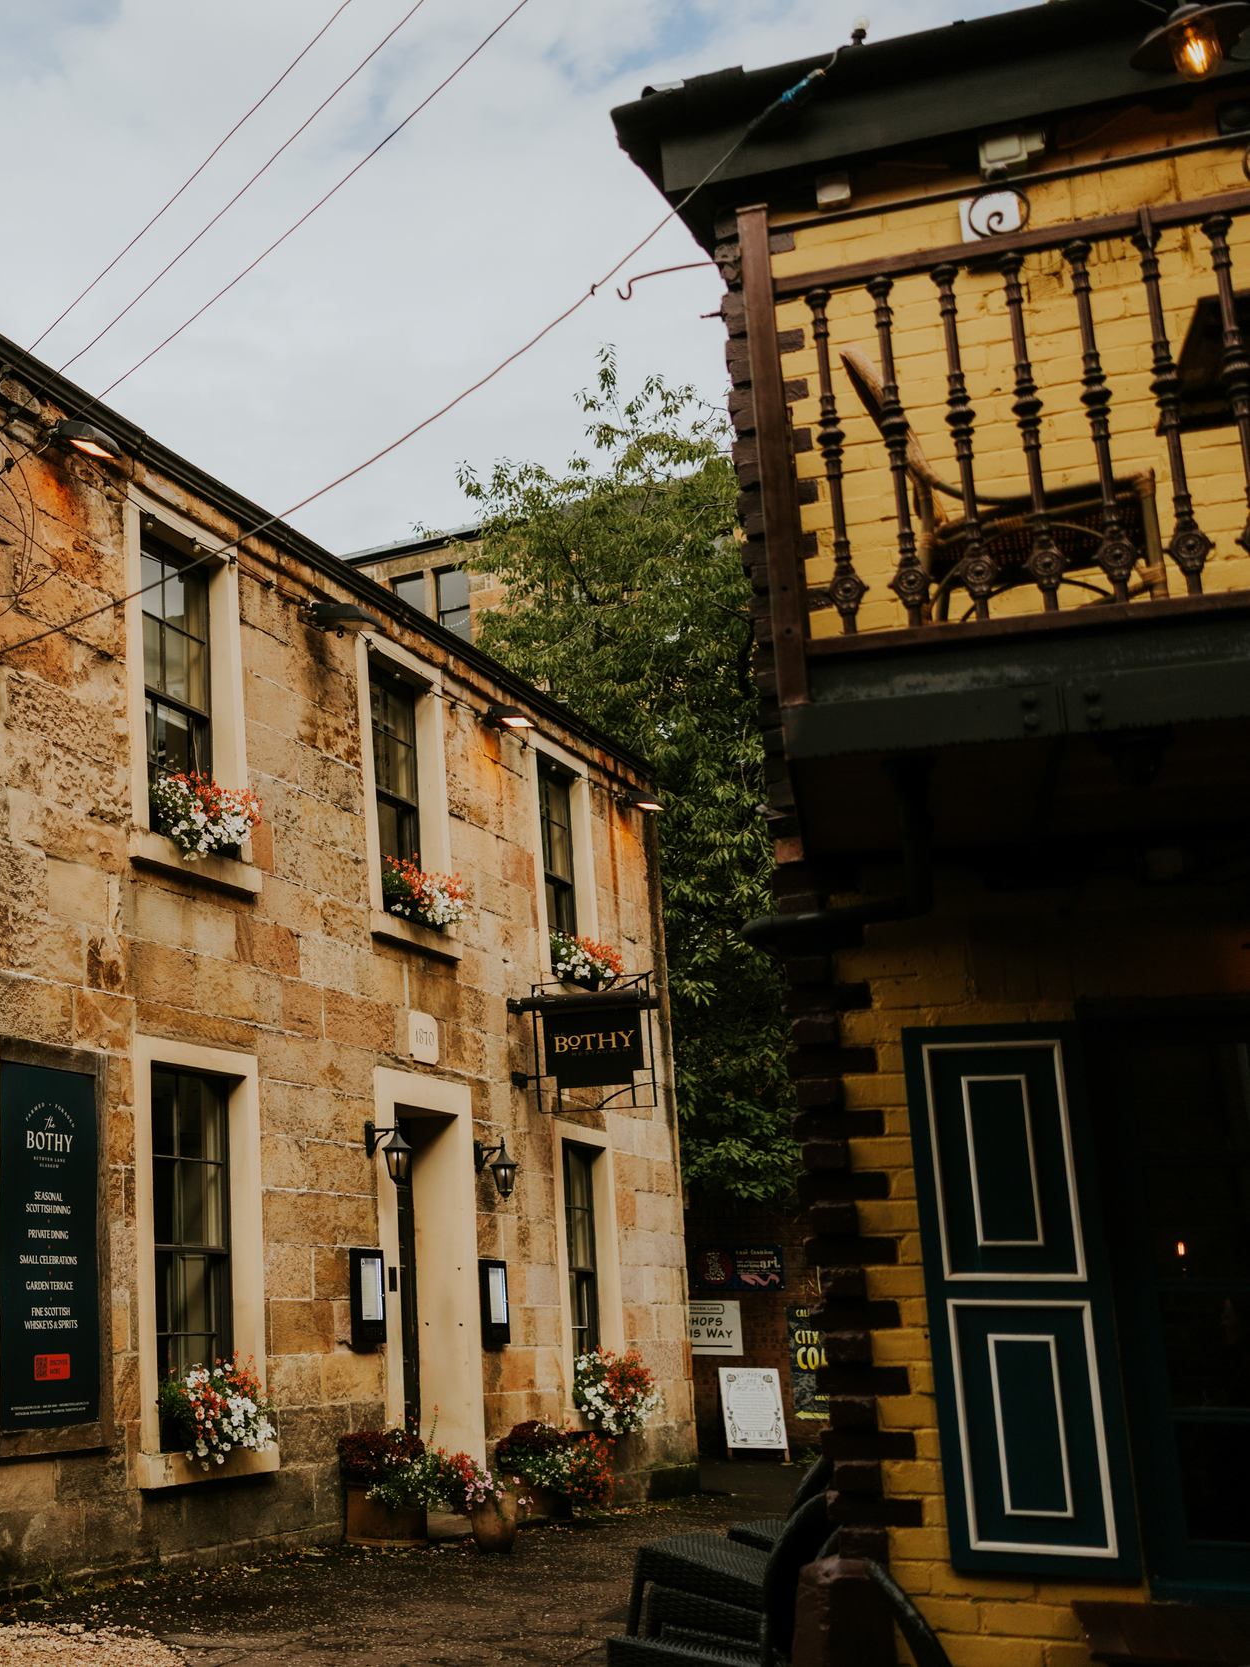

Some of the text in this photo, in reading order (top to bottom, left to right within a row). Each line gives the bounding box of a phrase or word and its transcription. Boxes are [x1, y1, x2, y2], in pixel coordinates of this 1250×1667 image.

[415, 1029, 435, 1046] 1870
[553, 1029, 636, 1053] BOTHY
[44, 1115, 57, 1131] the
[26, 1130, 73, 1153] BOTHY
[34, 1190, 63, 1202] SEASONAL
[25, 1203, 71, 1215] SCOTTISH DINING
[27, 1229, 69, 1240] PRIVATE DINING
[19, 1254, 78, 1265] SMALL CELEBRATIONS
[25, 1281, 74, 1290] GARDEN TERRACE
[31, 1306, 71, 1316] FINE SCOTTISH
[24, 1320, 53, 1330] WHISKEYS
[58, 1319, 79, 1329] SPIRITS
[689, 1316, 723, 1327] HOPS
[706, 1327, 732, 1339] WAY
[795, 1330, 820, 1344] CITY
